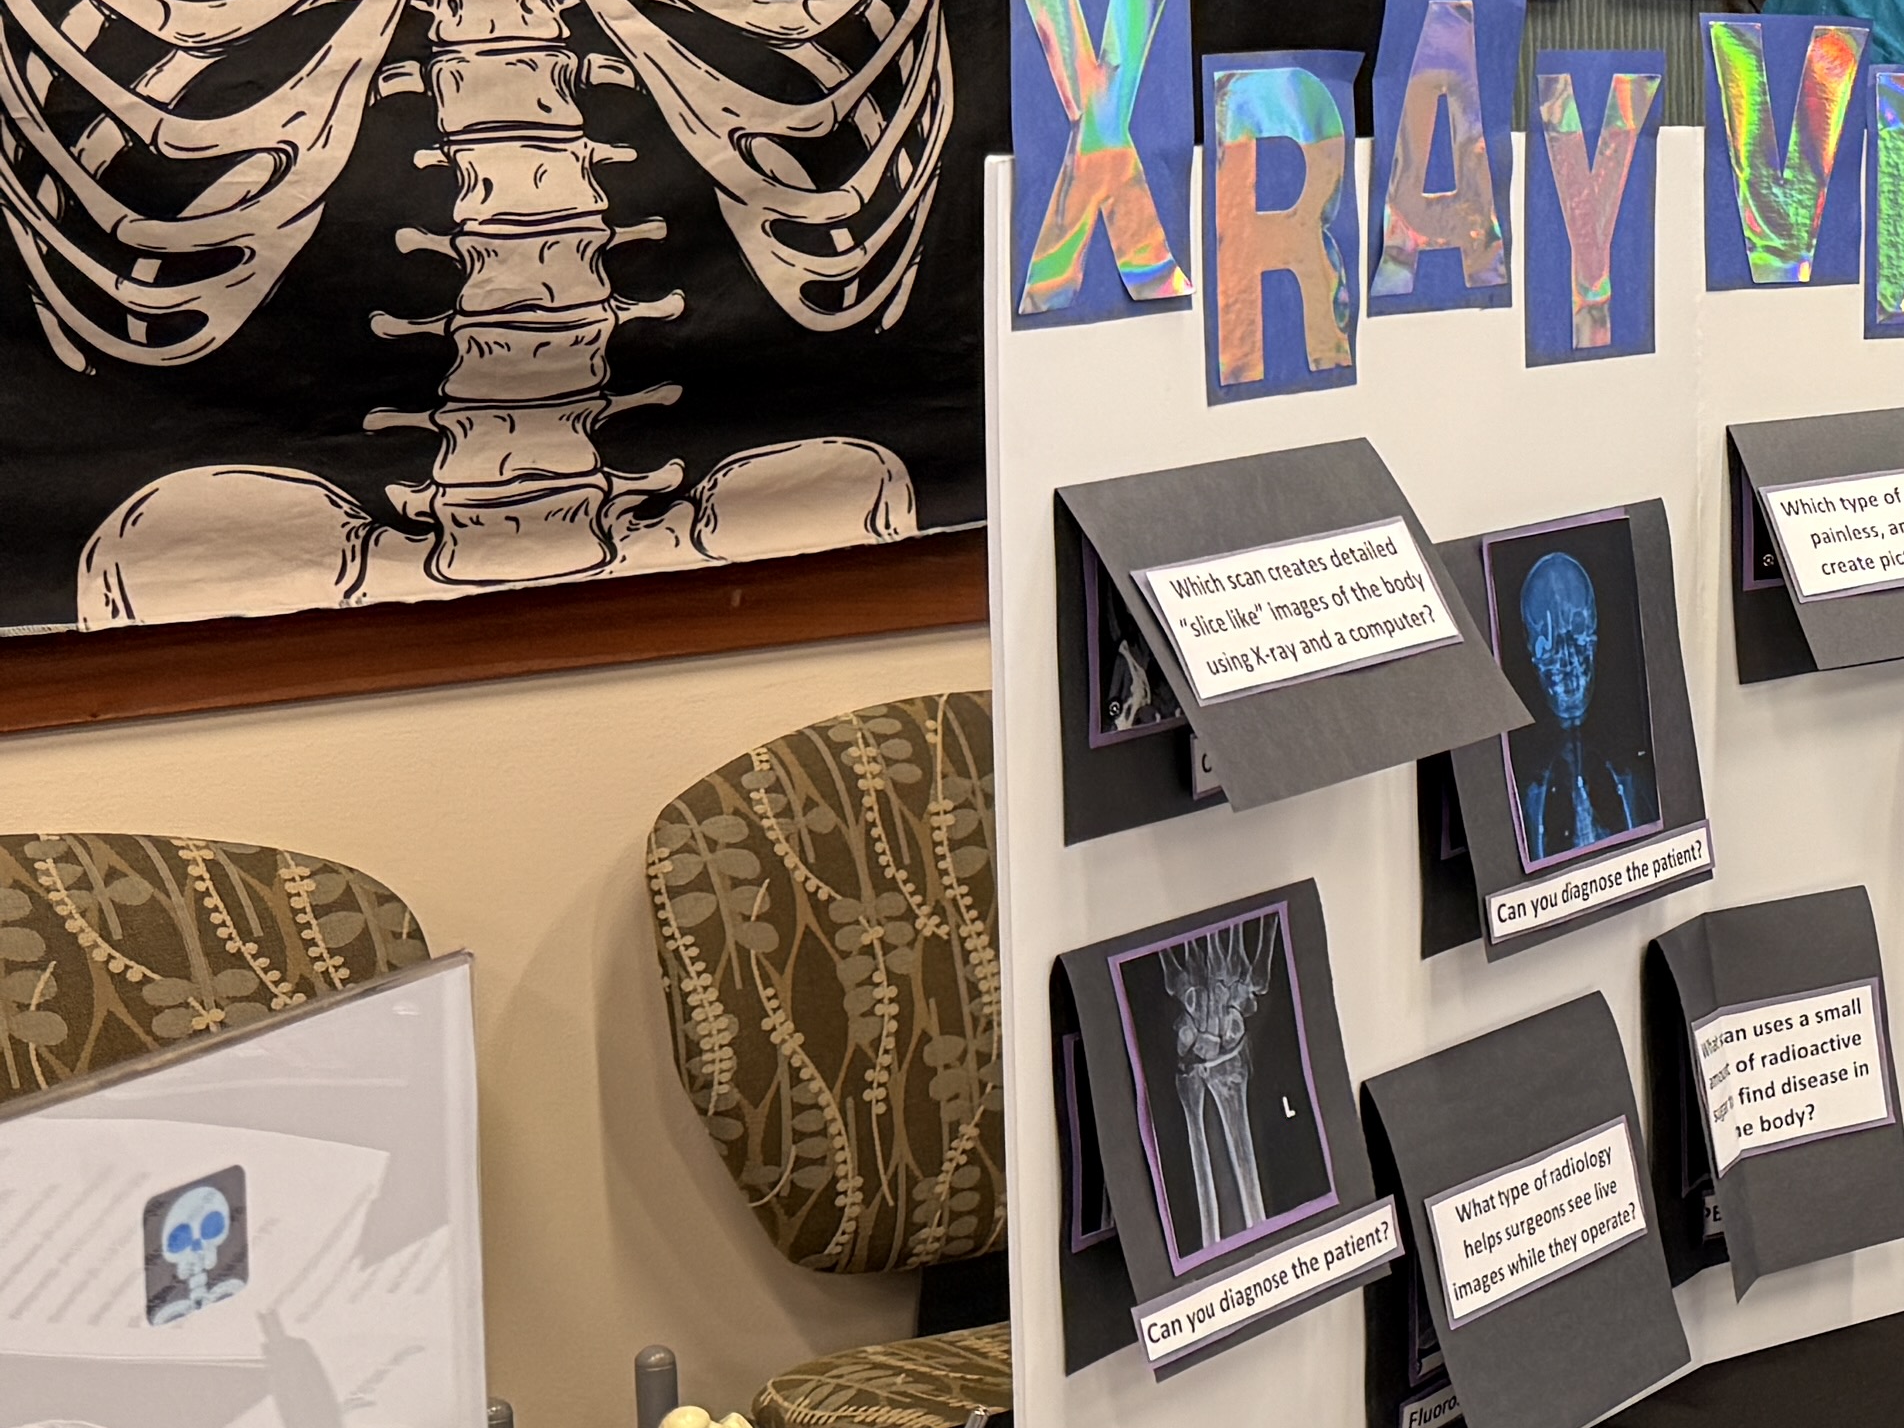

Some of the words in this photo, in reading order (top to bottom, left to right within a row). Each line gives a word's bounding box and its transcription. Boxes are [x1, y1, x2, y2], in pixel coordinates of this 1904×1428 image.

[1779, 496, 1836, 516] Which
[1839, 495, 1878, 513] type
[1883, 486, 1901, 504] of
[1810, 524, 1884, 549] painless,
[1168, 572, 1225, 599] Which
[1226, 569, 1266, 589] scan
[1267, 556, 1327, 581] creates
[1329, 535, 1397, 567] detailed
[1821, 556, 1875, 575] create
[1266, 595, 1329, 620] images
[1331, 584, 1349, 606] of
[1349, 581, 1382, 601] the
[1379, 570, 1425, 594] body
[1206, 651, 1254, 675] using
[1249, 642, 1298, 665] X-ray
[1299, 629, 1332, 654] and
[1333, 631, 1347, 645] a
[1348, 604, 1435, 641] computer?
[1147, 1318, 1182, 1343] Can
[1185, 1302, 1215, 1333] you
[1219, 1269, 1288, 1312] diagnose
[1290, 1256, 1319, 1279] the
[1323, 1220, 1388, 1271] patient?
